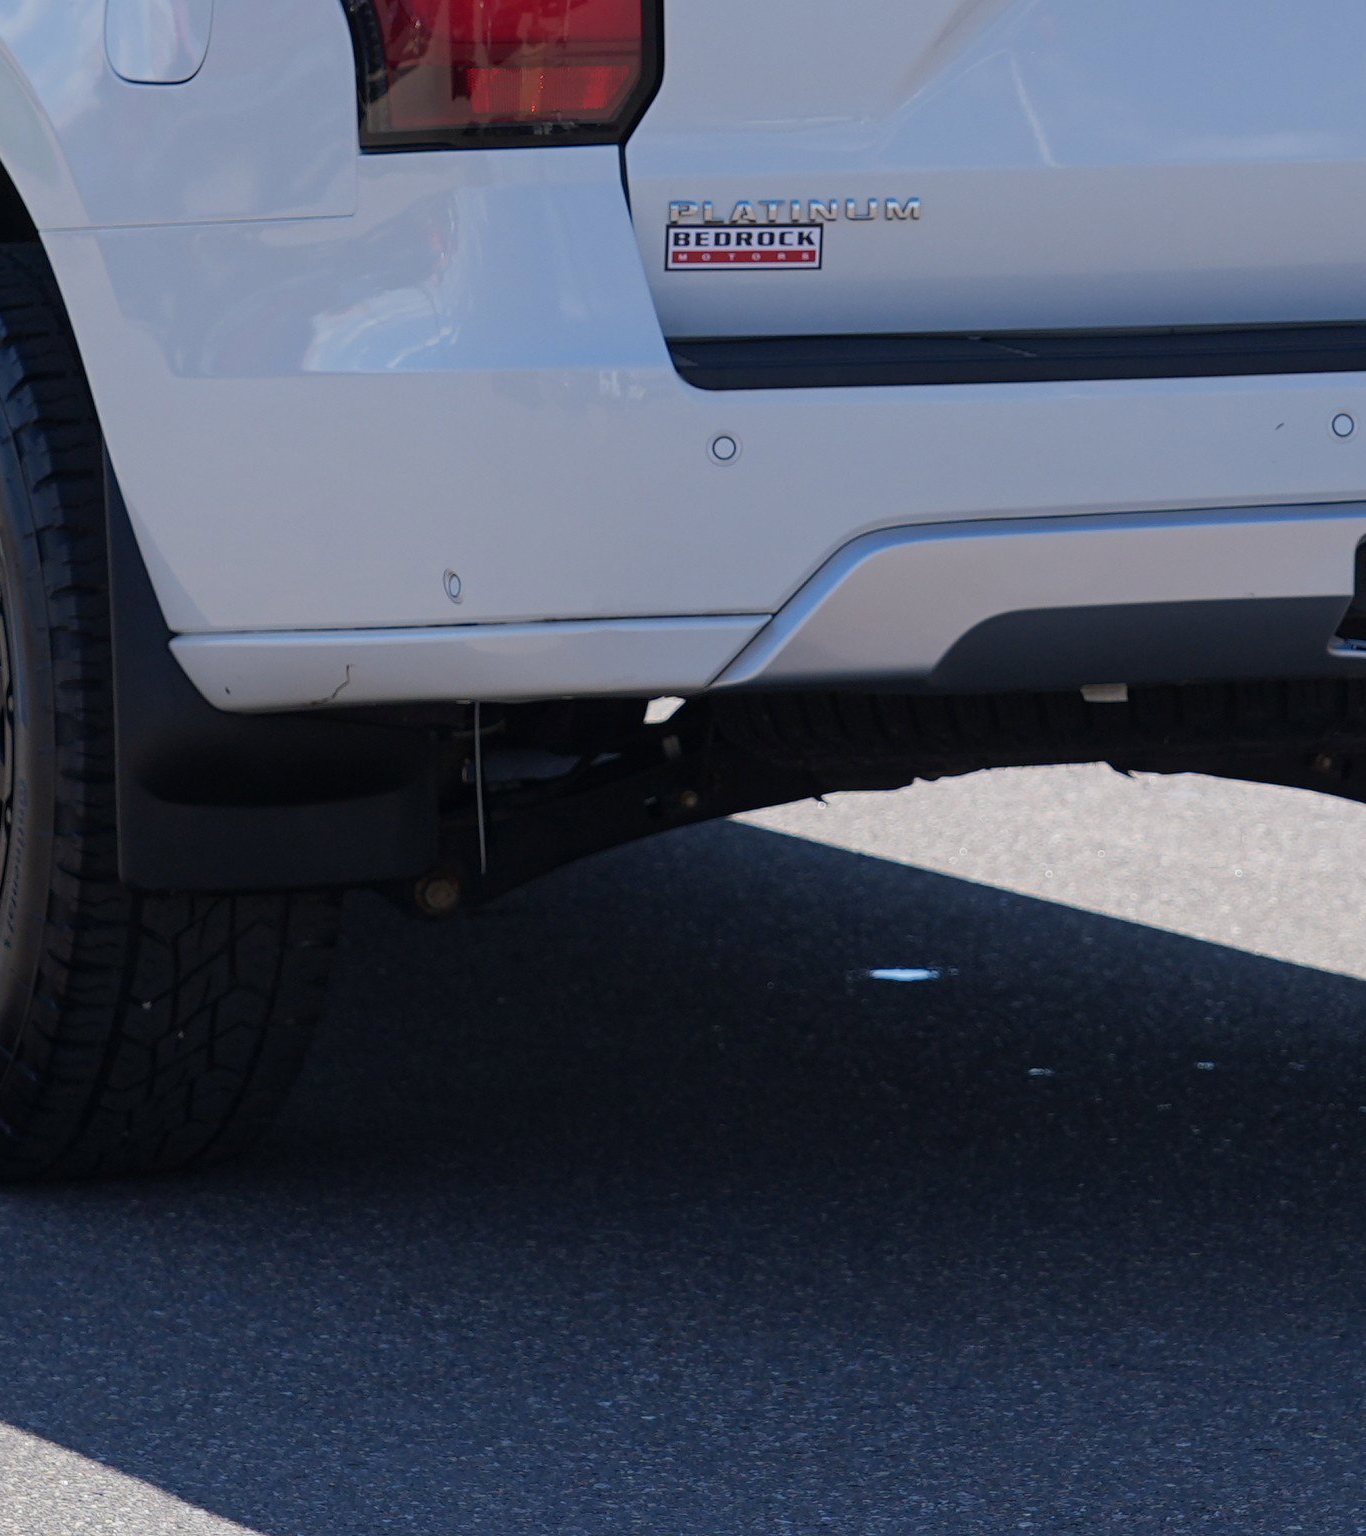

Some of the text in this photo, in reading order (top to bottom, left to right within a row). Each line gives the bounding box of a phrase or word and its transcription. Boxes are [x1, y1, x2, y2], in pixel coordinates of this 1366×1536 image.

[668, 196, 922, 224] PLATINUM
[672, 230, 816, 247] BEDROCK
[677, 252, 810, 262] MOTORS
